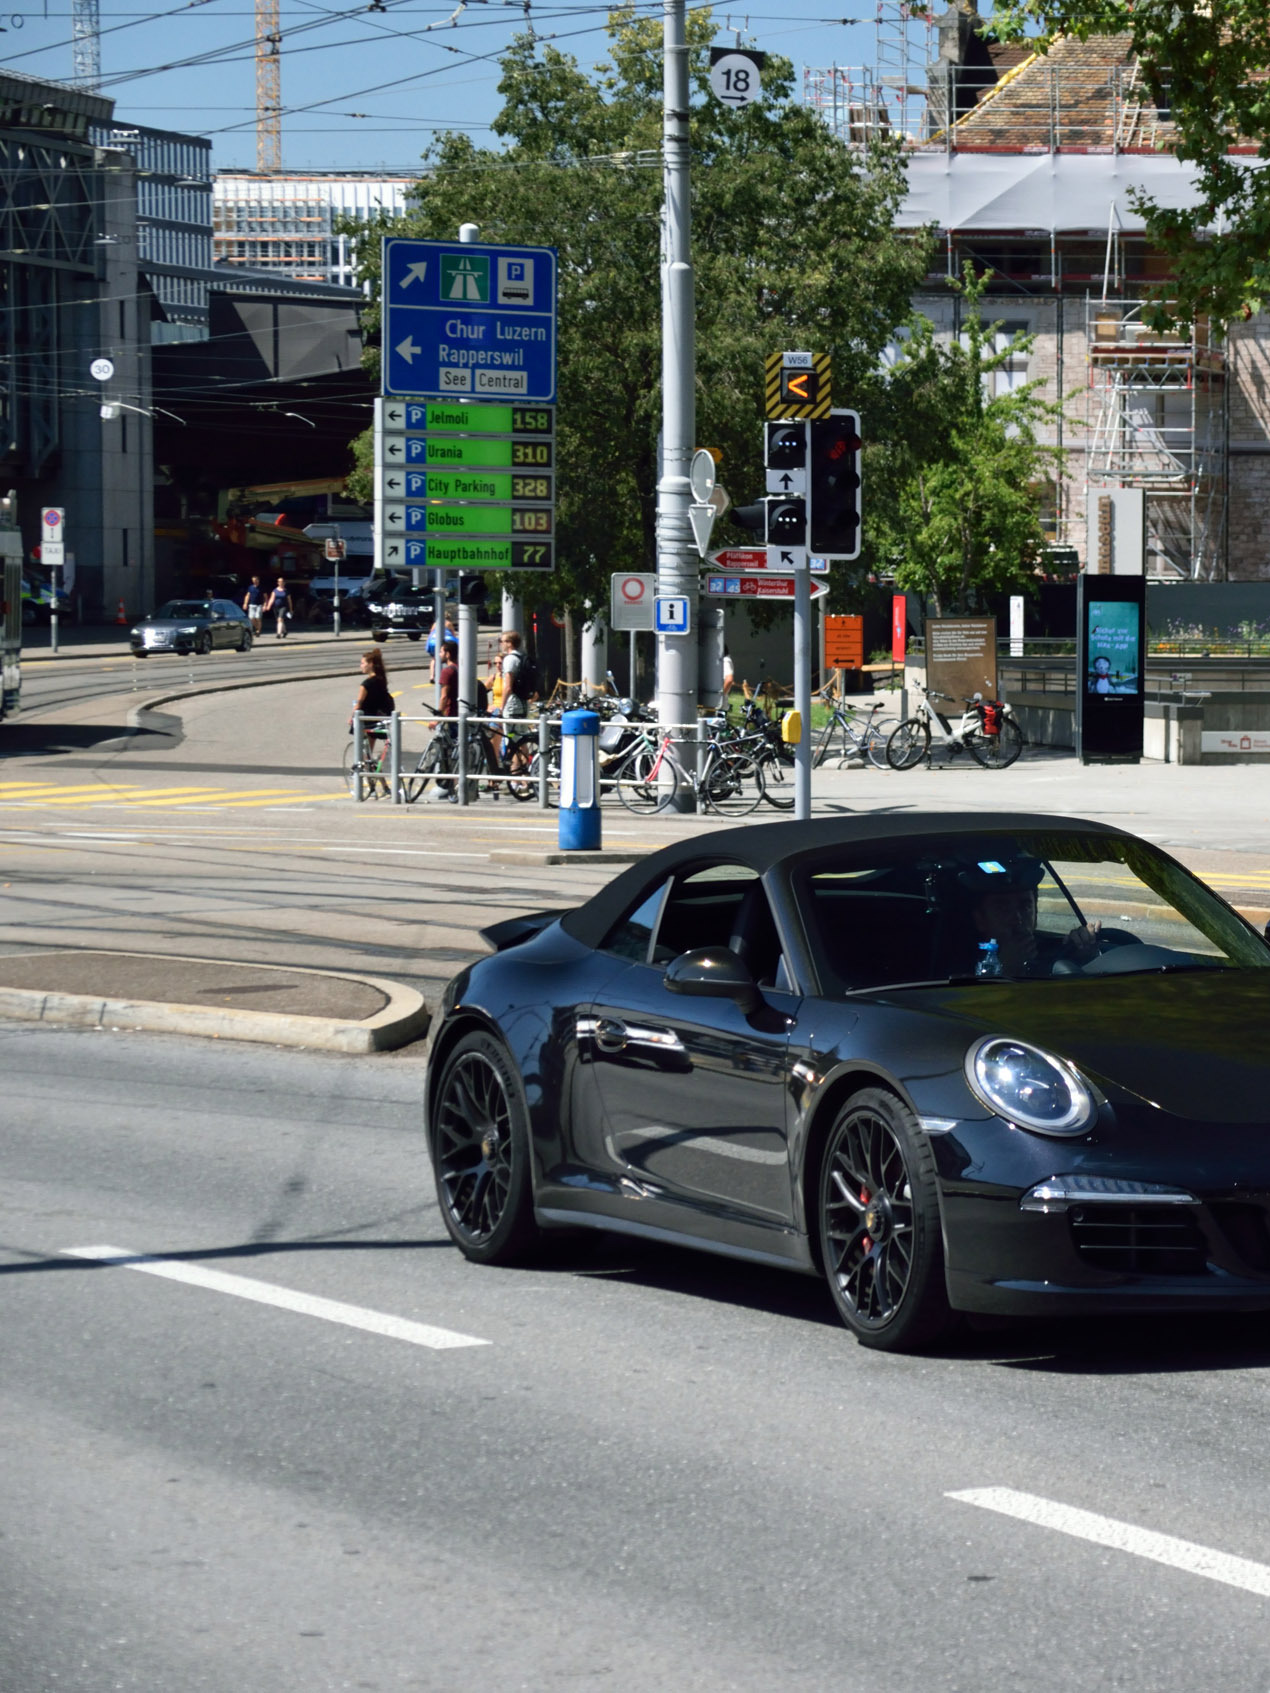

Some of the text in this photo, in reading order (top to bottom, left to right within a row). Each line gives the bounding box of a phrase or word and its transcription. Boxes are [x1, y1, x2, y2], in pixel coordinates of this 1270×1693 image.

[721, 68, 750, 92] 18
[445, 319, 546, 341] Chur Luzern
[439, 344, 523, 367] Rapperswil
[788, 356, 808, 364] W56
[95, 364, 110, 374] 30
[444, 371, 466, 386] See
[479, 373, 524, 388] Central
[429, 411, 469, 425] Jelmoli
[514, 411, 548, 429] 158
[428, 445, 463, 459] Urania
[513, 445, 548, 463] 310
[428, 478, 449, 495] City
[455, 479, 496, 496] Parking
[513, 479, 548, 497] 328
[428, 512, 464, 526] Globus
[513, 512, 548, 531] 103
[428, 545, 510, 564] Hauptbahnhof
[523, 546, 547, 563] 77
